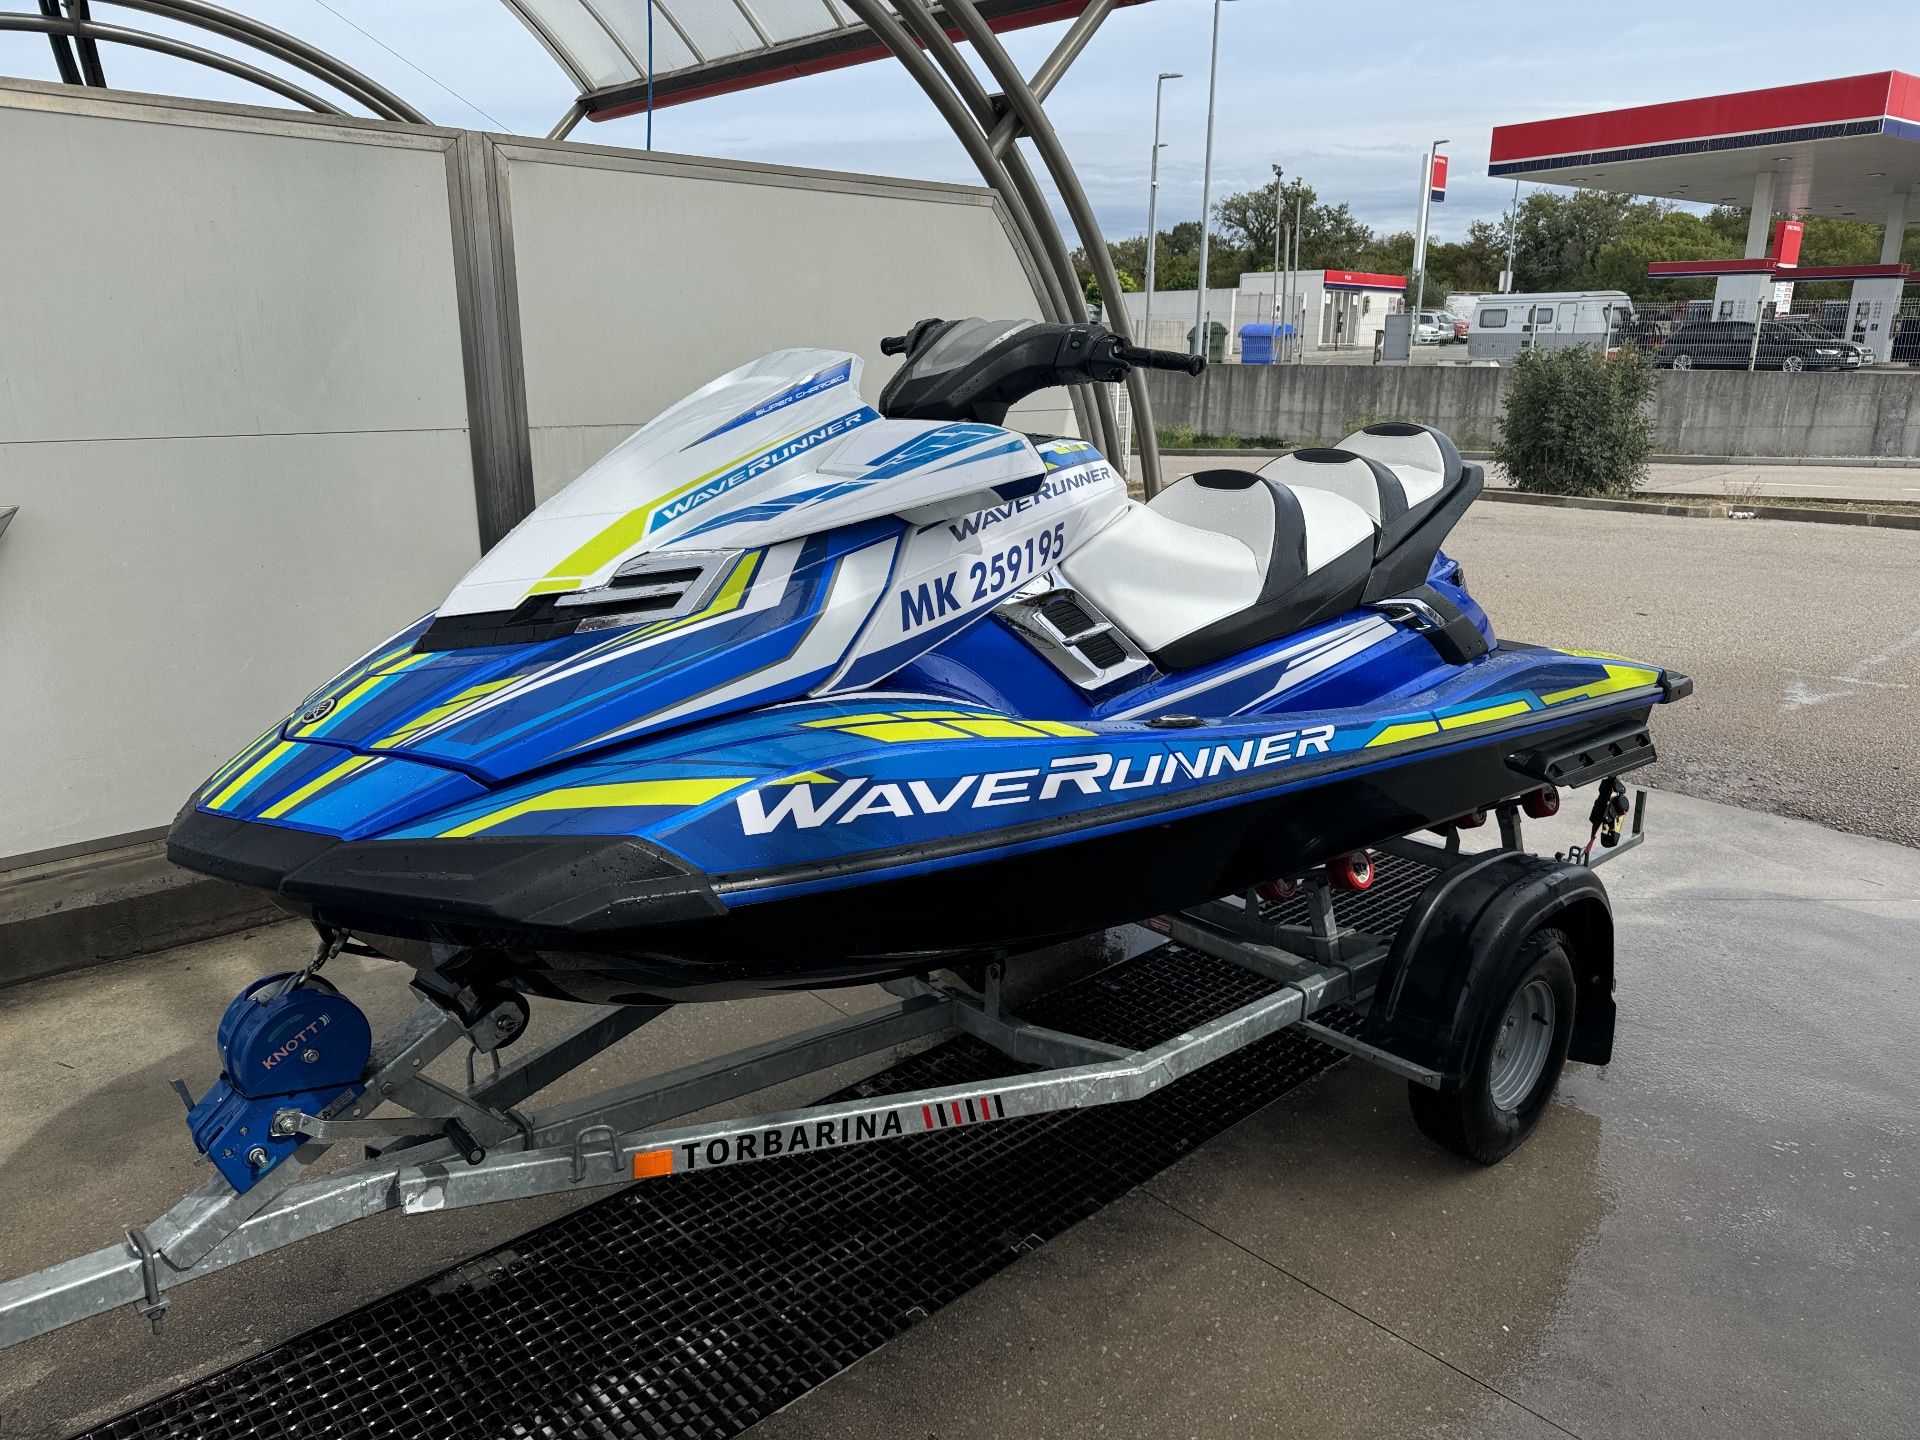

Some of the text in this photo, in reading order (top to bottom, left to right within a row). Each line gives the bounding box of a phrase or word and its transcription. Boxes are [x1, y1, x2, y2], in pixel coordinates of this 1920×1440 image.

[755, 396, 793, 417] SUPER
[661, 412, 862, 520] WAVERUNNER
[900, 521, 1065, 632] MK 259195
[735, 724, 1336, 837] WAVERUNNER
[262, 1021, 319, 1070] KNOTT
[681, 1109, 901, 1169] TORBARINA
